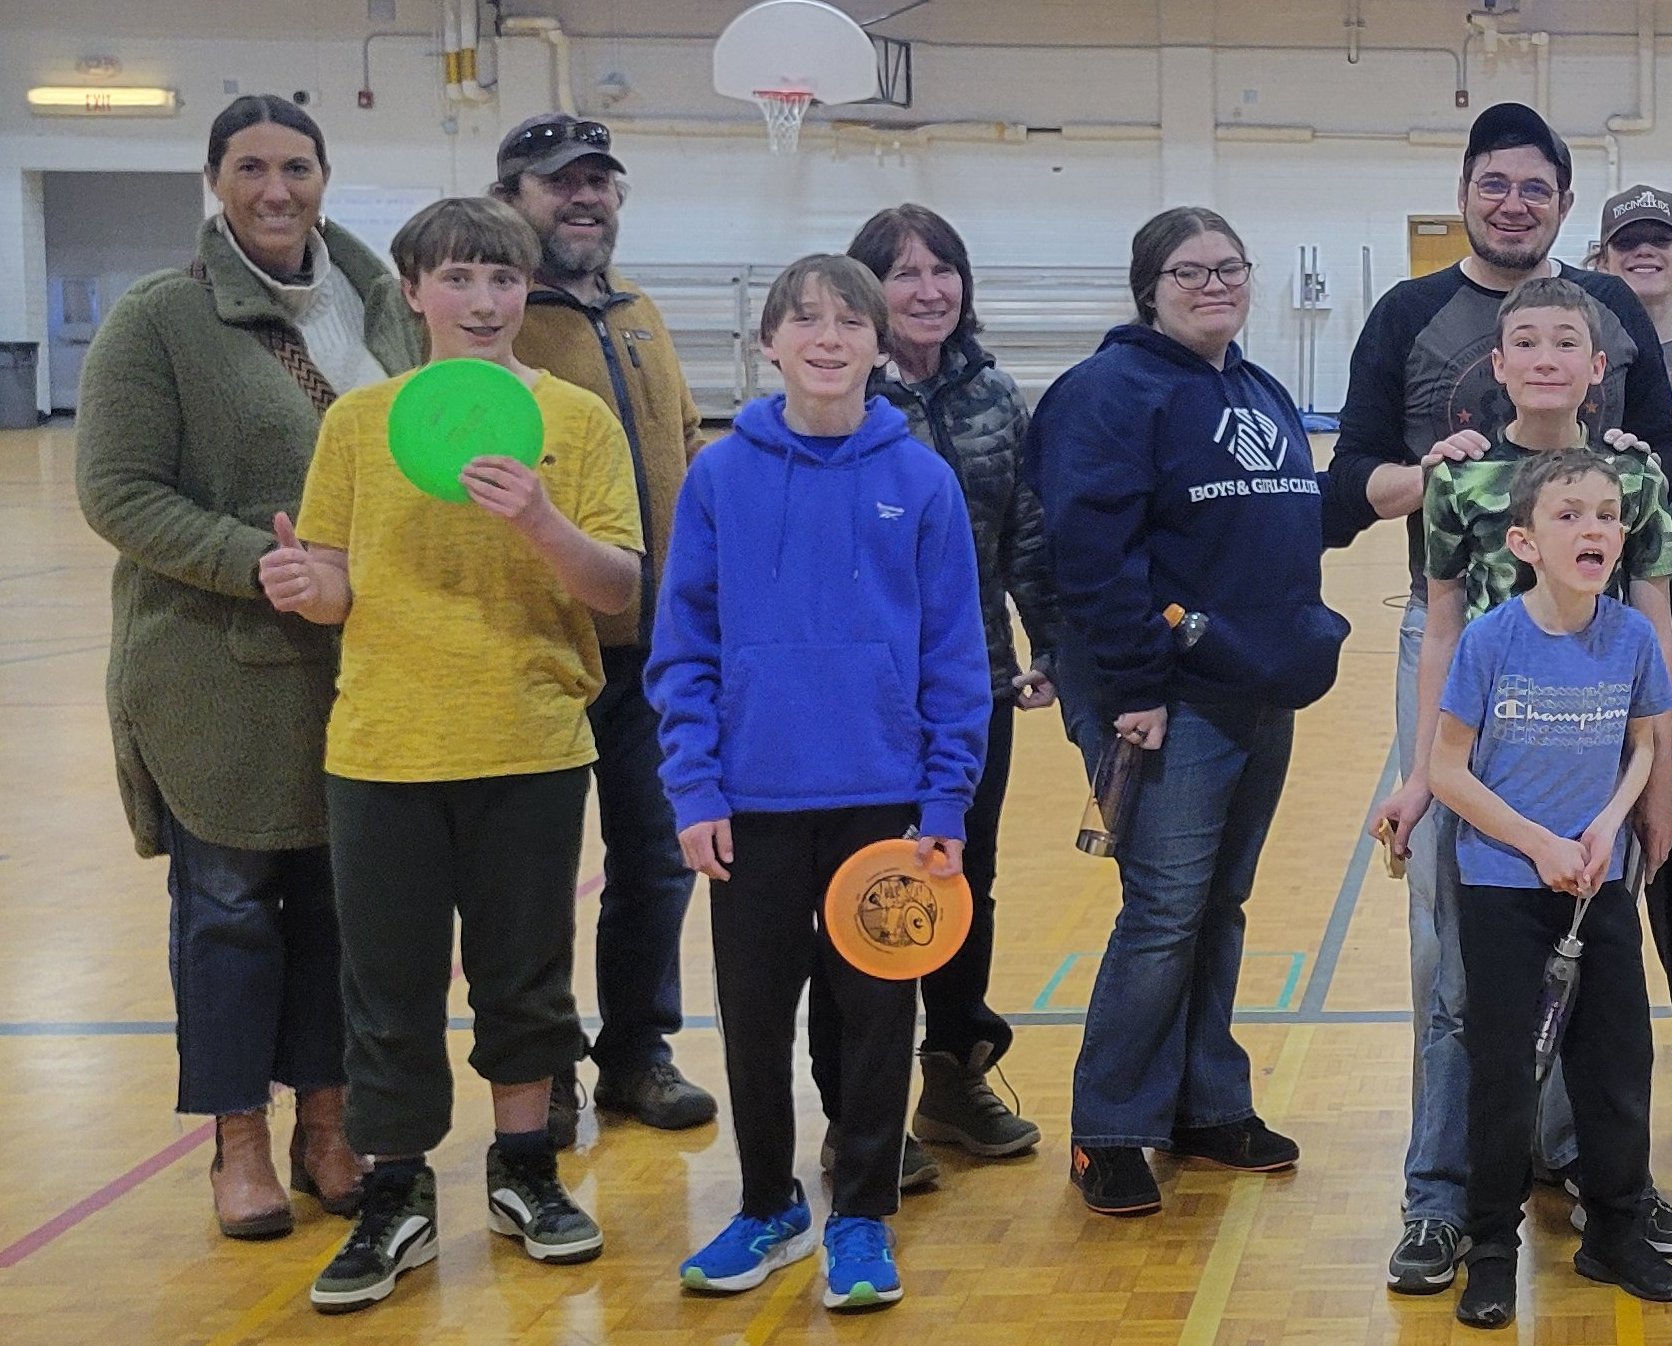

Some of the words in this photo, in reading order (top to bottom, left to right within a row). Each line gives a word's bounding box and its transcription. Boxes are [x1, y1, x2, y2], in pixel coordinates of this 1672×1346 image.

[85, 94, 112, 112] EXIT
[1188, 480, 1236, 503] BOYS
[1236, 480, 1252, 496] &
[1252, 477, 1289, 494] GIRLS
[1493, 699, 1629, 731] Champion
